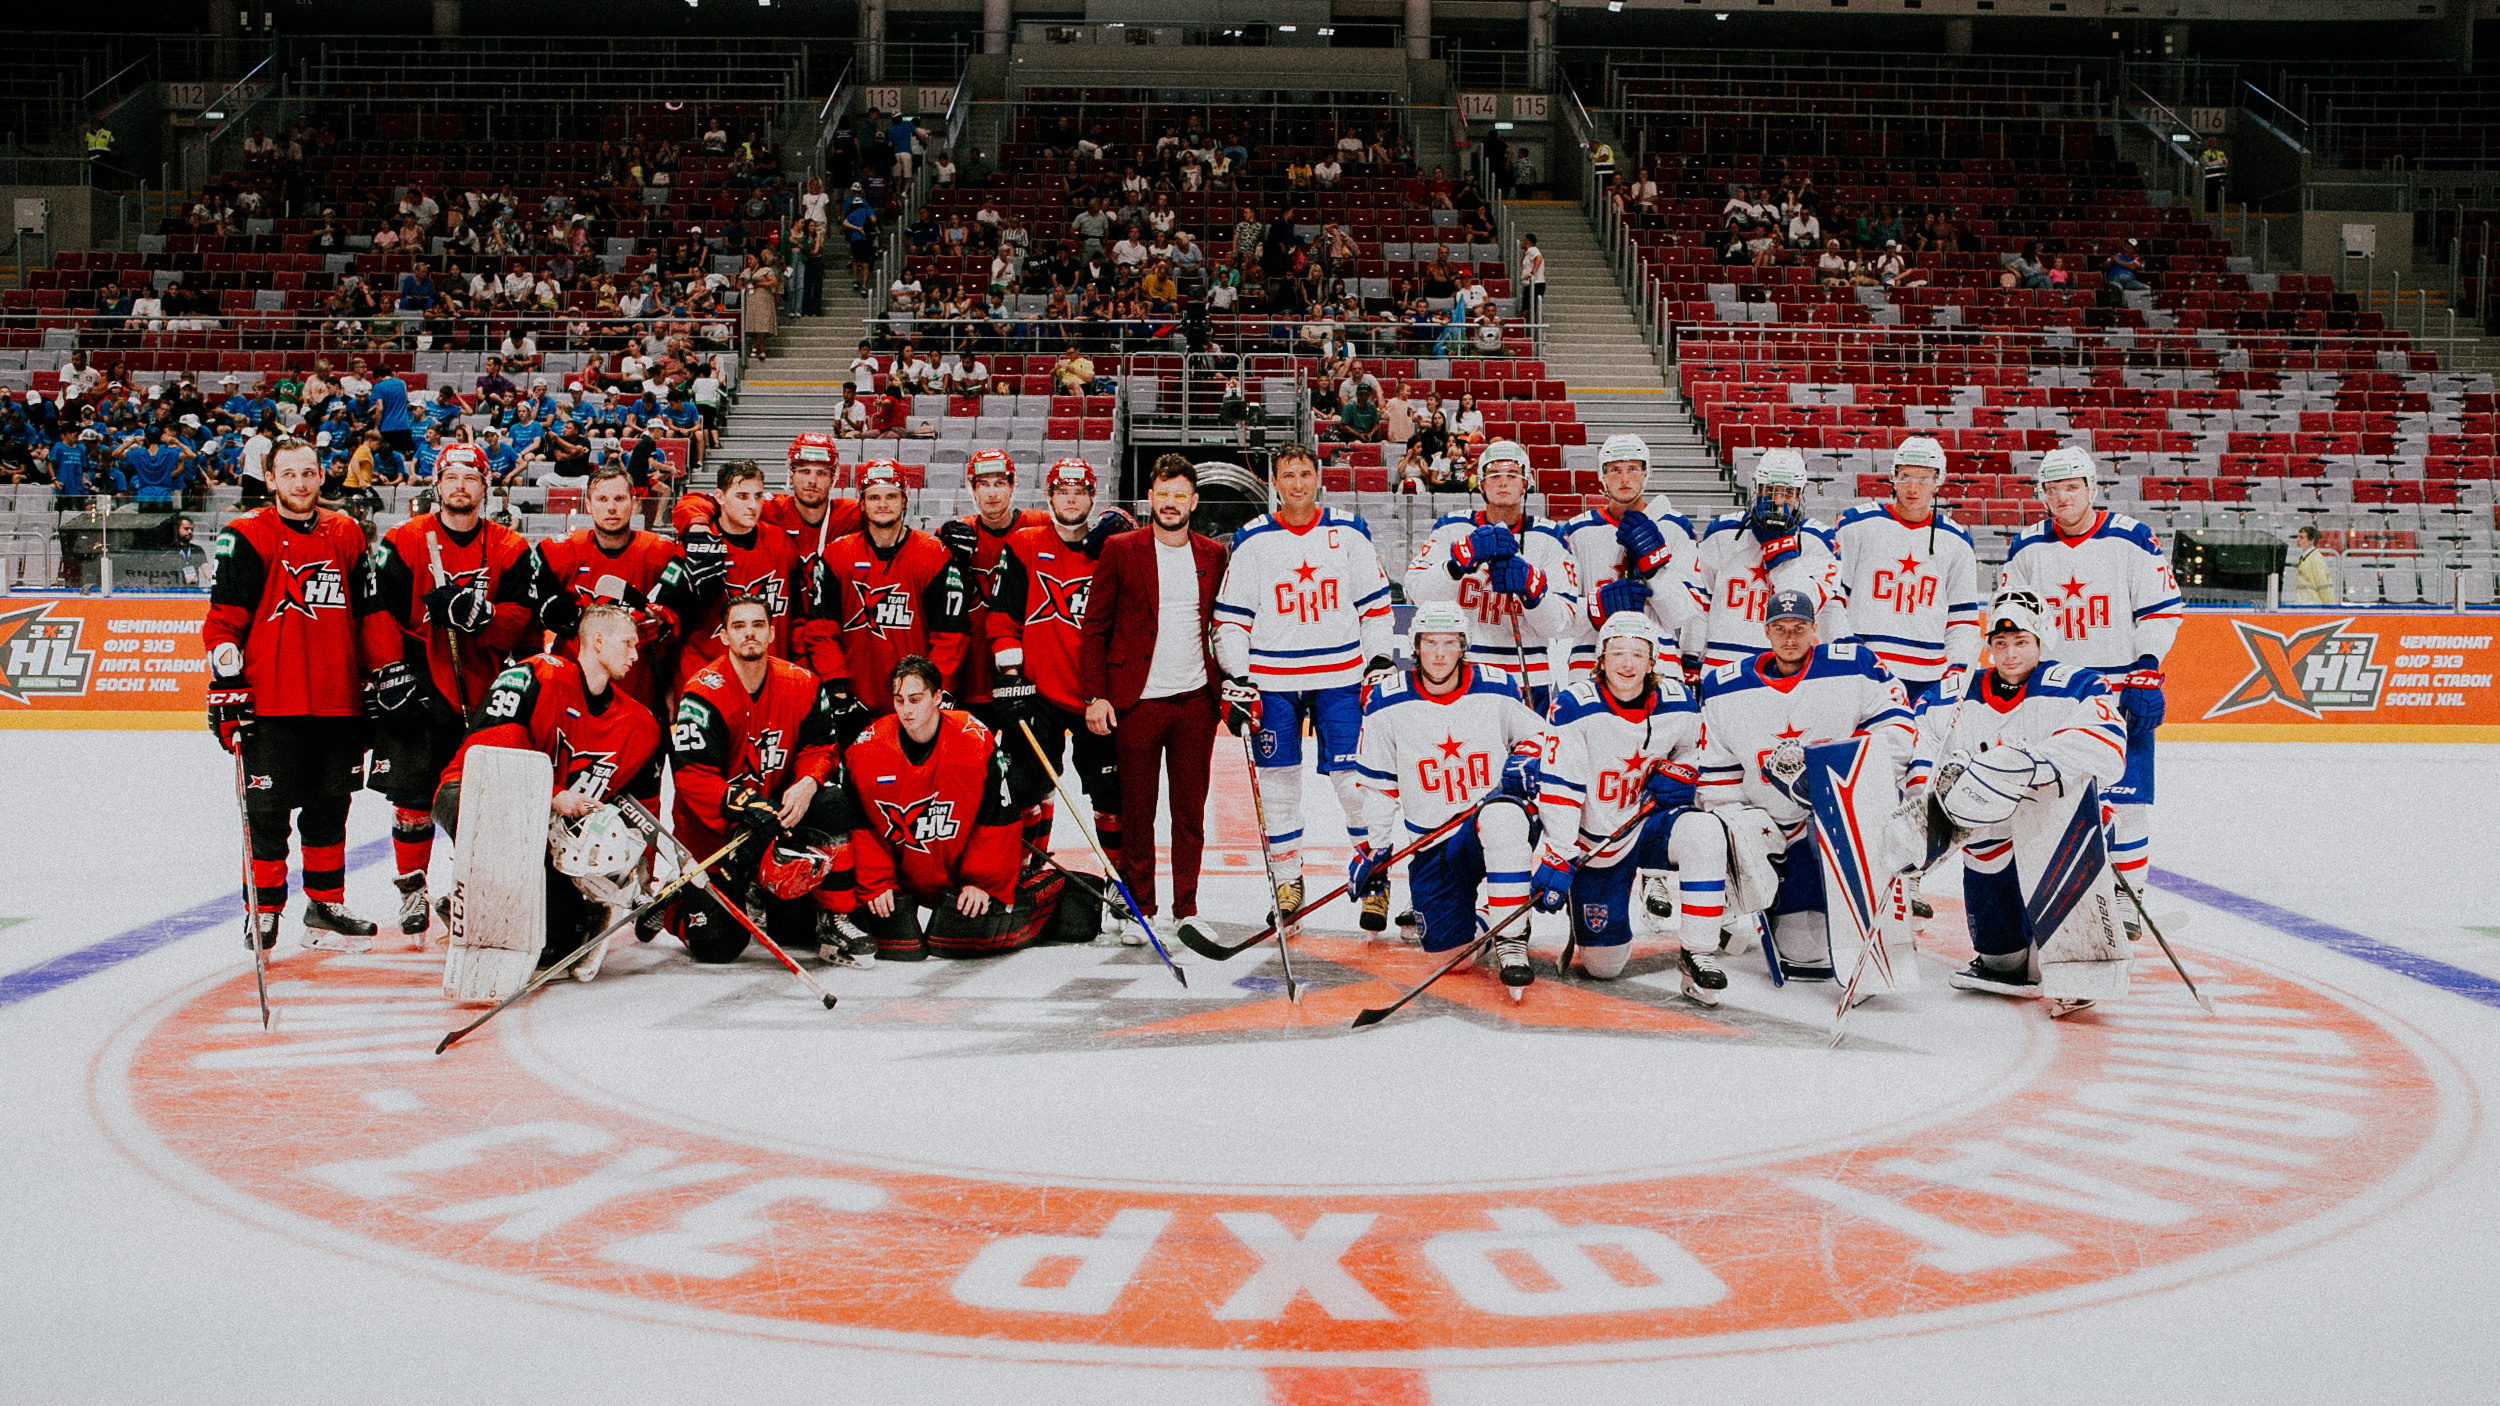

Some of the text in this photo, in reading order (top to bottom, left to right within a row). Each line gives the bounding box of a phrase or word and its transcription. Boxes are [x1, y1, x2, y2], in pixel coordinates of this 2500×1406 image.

[171, 85, 203, 105] 112
[867, 89, 898, 108] 113
[920, 89, 952, 108] 114
[1463, 96, 1494, 115] 114
[1515, 97, 1546, 116] 115
[2193, 109, 2223, 129] 116
[1274, 576, 1340, 625] СКА
[1727, 577, 1775, 622] СК
[1872, 569, 1939, 616] СКА
[945, 591, 964, 617] 17
[107, 619, 206, 634] ЧЕМПИОНАТ
[102, 639, 140, 653] ФХР
[2400, 635, 2494, 650] ЧЕМПИОНАТ
[99, 658, 206, 673] ЛИГА СТАВОК
[2395, 655, 2430, 668] ФХР
[95, 678, 180, 692] SOCHI XHL
[2389, 674, 2493, 688] ЛИГА СТАВОК
[486, 689, 521, 718] 39
[2385, 693, 2433, 707] SOCHI
[2435, 694, 2466, 707] XHL
[674, 723, 707, 751] 25
[1416, 751, 1493, 804] СКА
[1596, 769, 1646, 811] СК
[452, 881, 466, 938] CCM
[2095, 893, 2116, 949] BAUER
